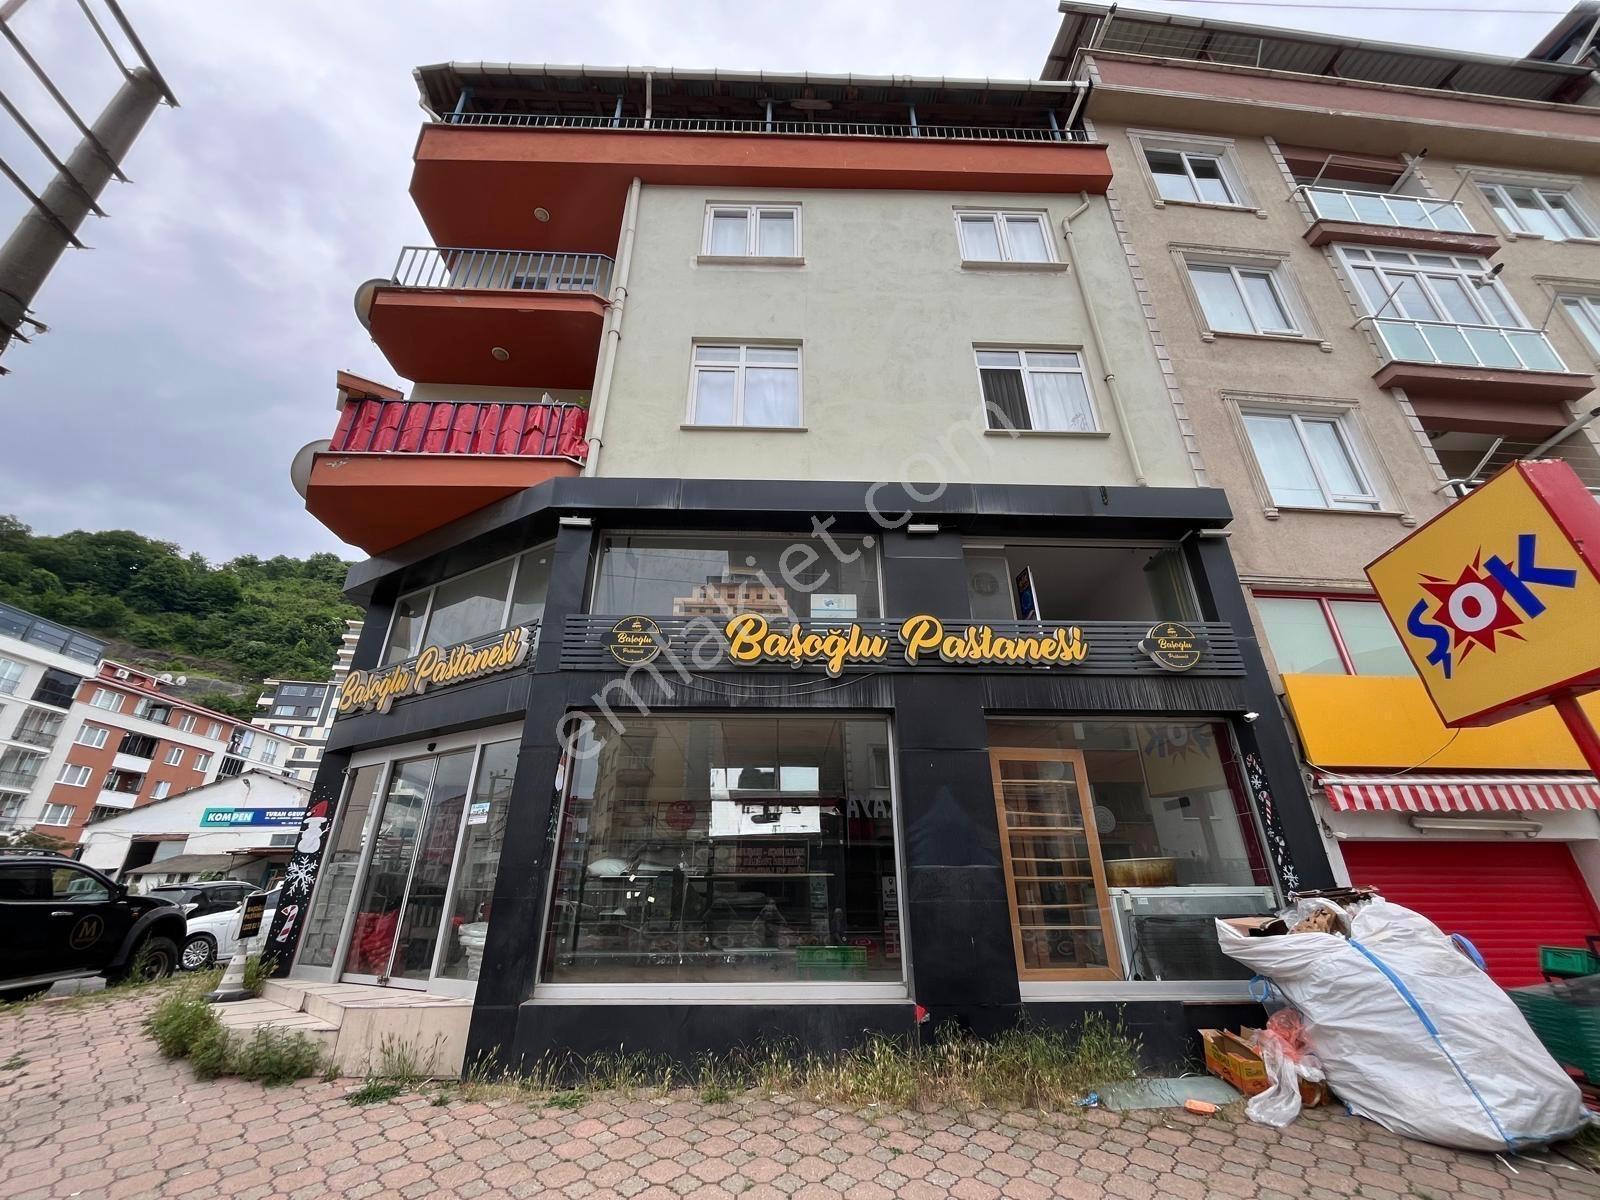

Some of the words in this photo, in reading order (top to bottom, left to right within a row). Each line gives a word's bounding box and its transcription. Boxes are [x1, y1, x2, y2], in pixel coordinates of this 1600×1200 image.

[725, 612, 889, 675] Başoğlu
[900, 613, 1090, 663] Pastanesi
[1406, 533, 1577, 680] ŞOK
[339, 664, 411, 712] Başoğlu
[413, 626, 523, 692] Pastanesi
[207, 812, 253, 822] KOMPEN
